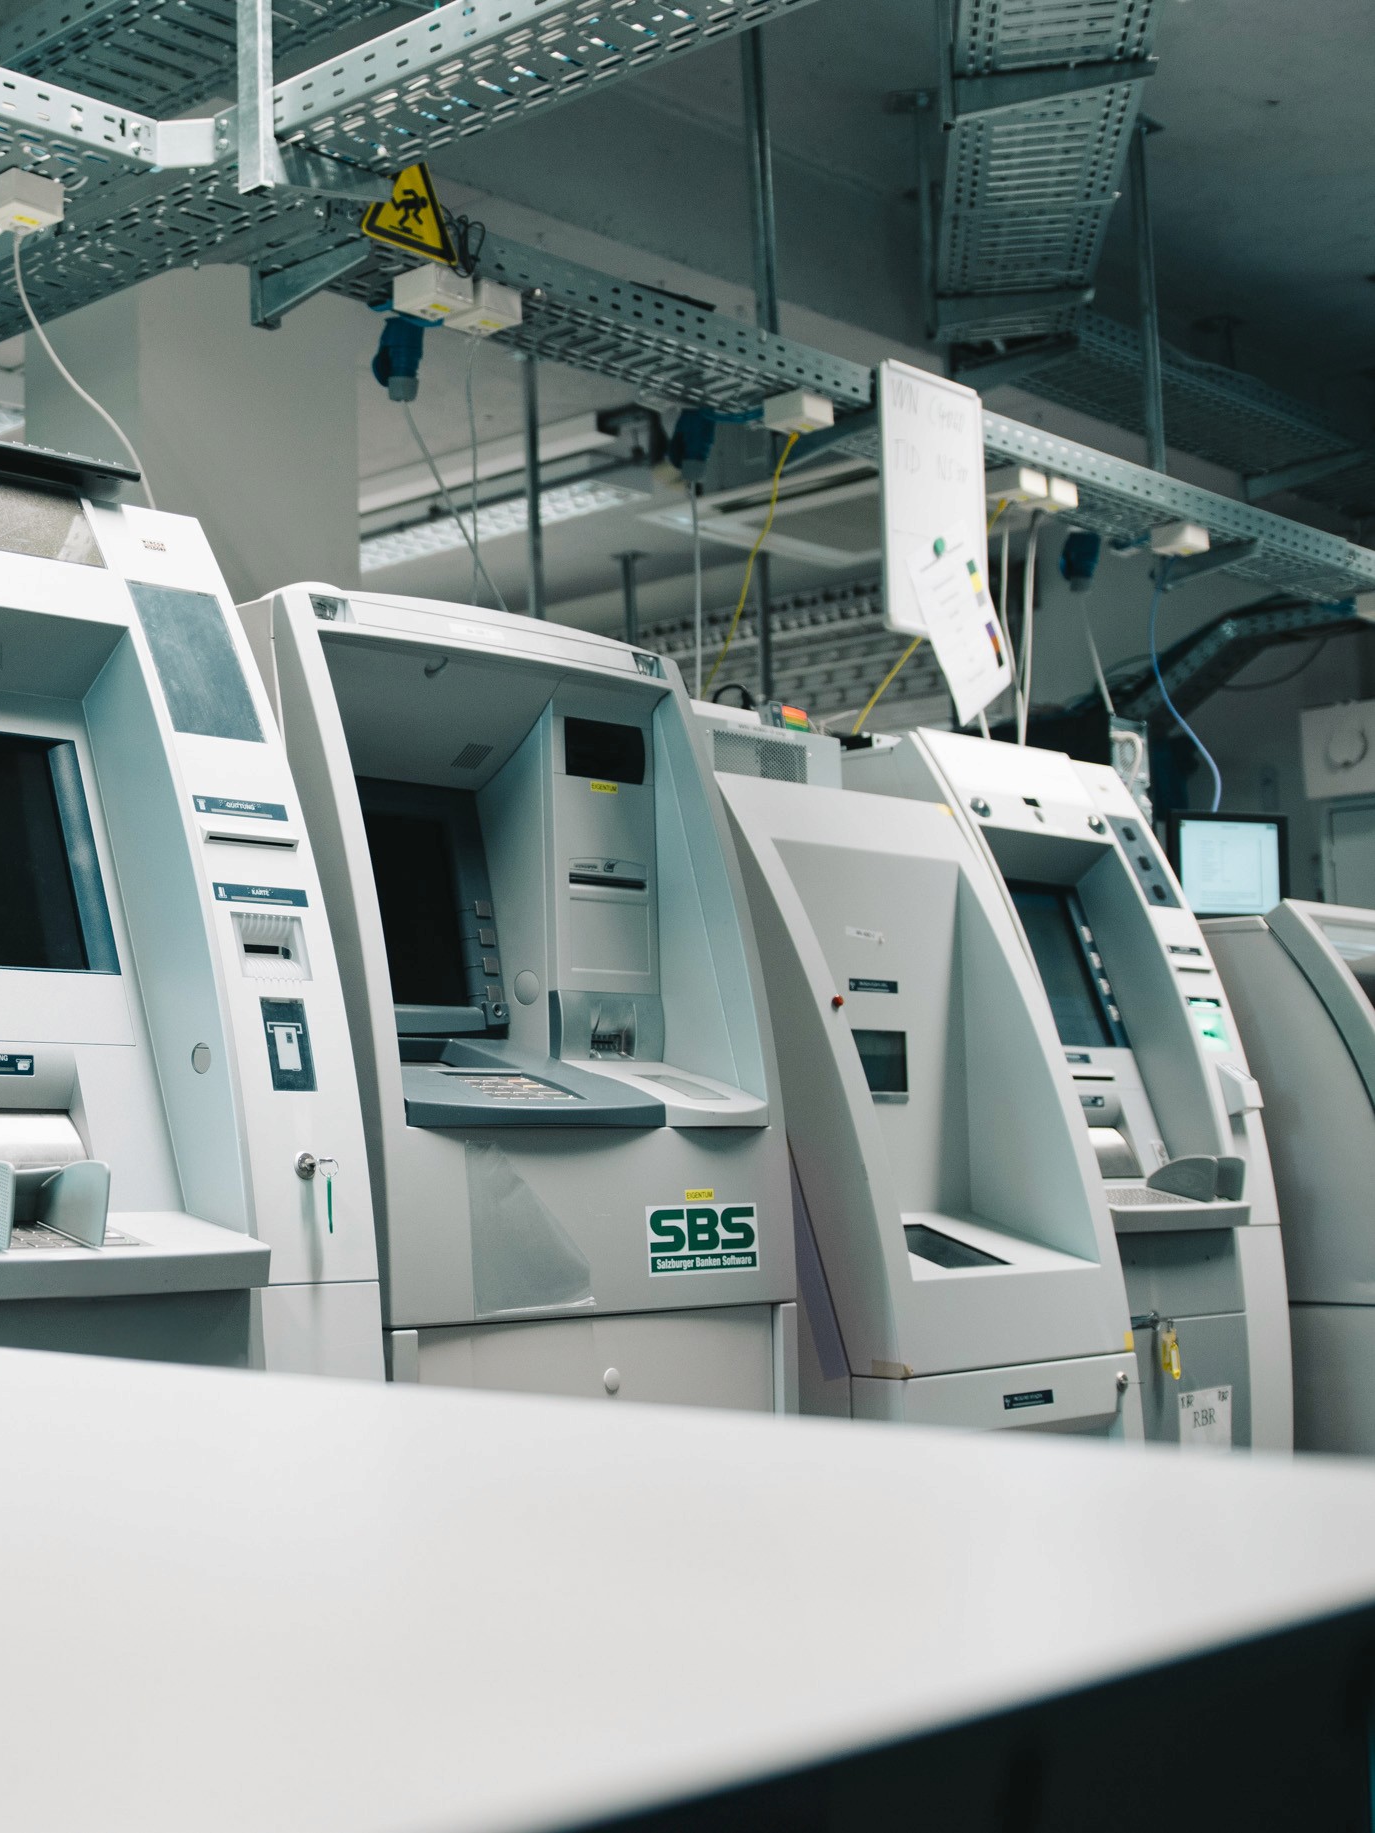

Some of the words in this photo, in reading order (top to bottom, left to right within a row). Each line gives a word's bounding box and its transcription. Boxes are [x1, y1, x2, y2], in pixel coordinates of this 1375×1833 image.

[686, 1191, 713, 1200] EIGENTUM
[650, 1206, 755, 1253] SBS
[656, 1258, 695, 1271] Salzburger
[695, 1256, 722, 1267] Banken
[722, 1254, 753, 1266] Software
[1192, 1407, 1216, 1429] RBR
